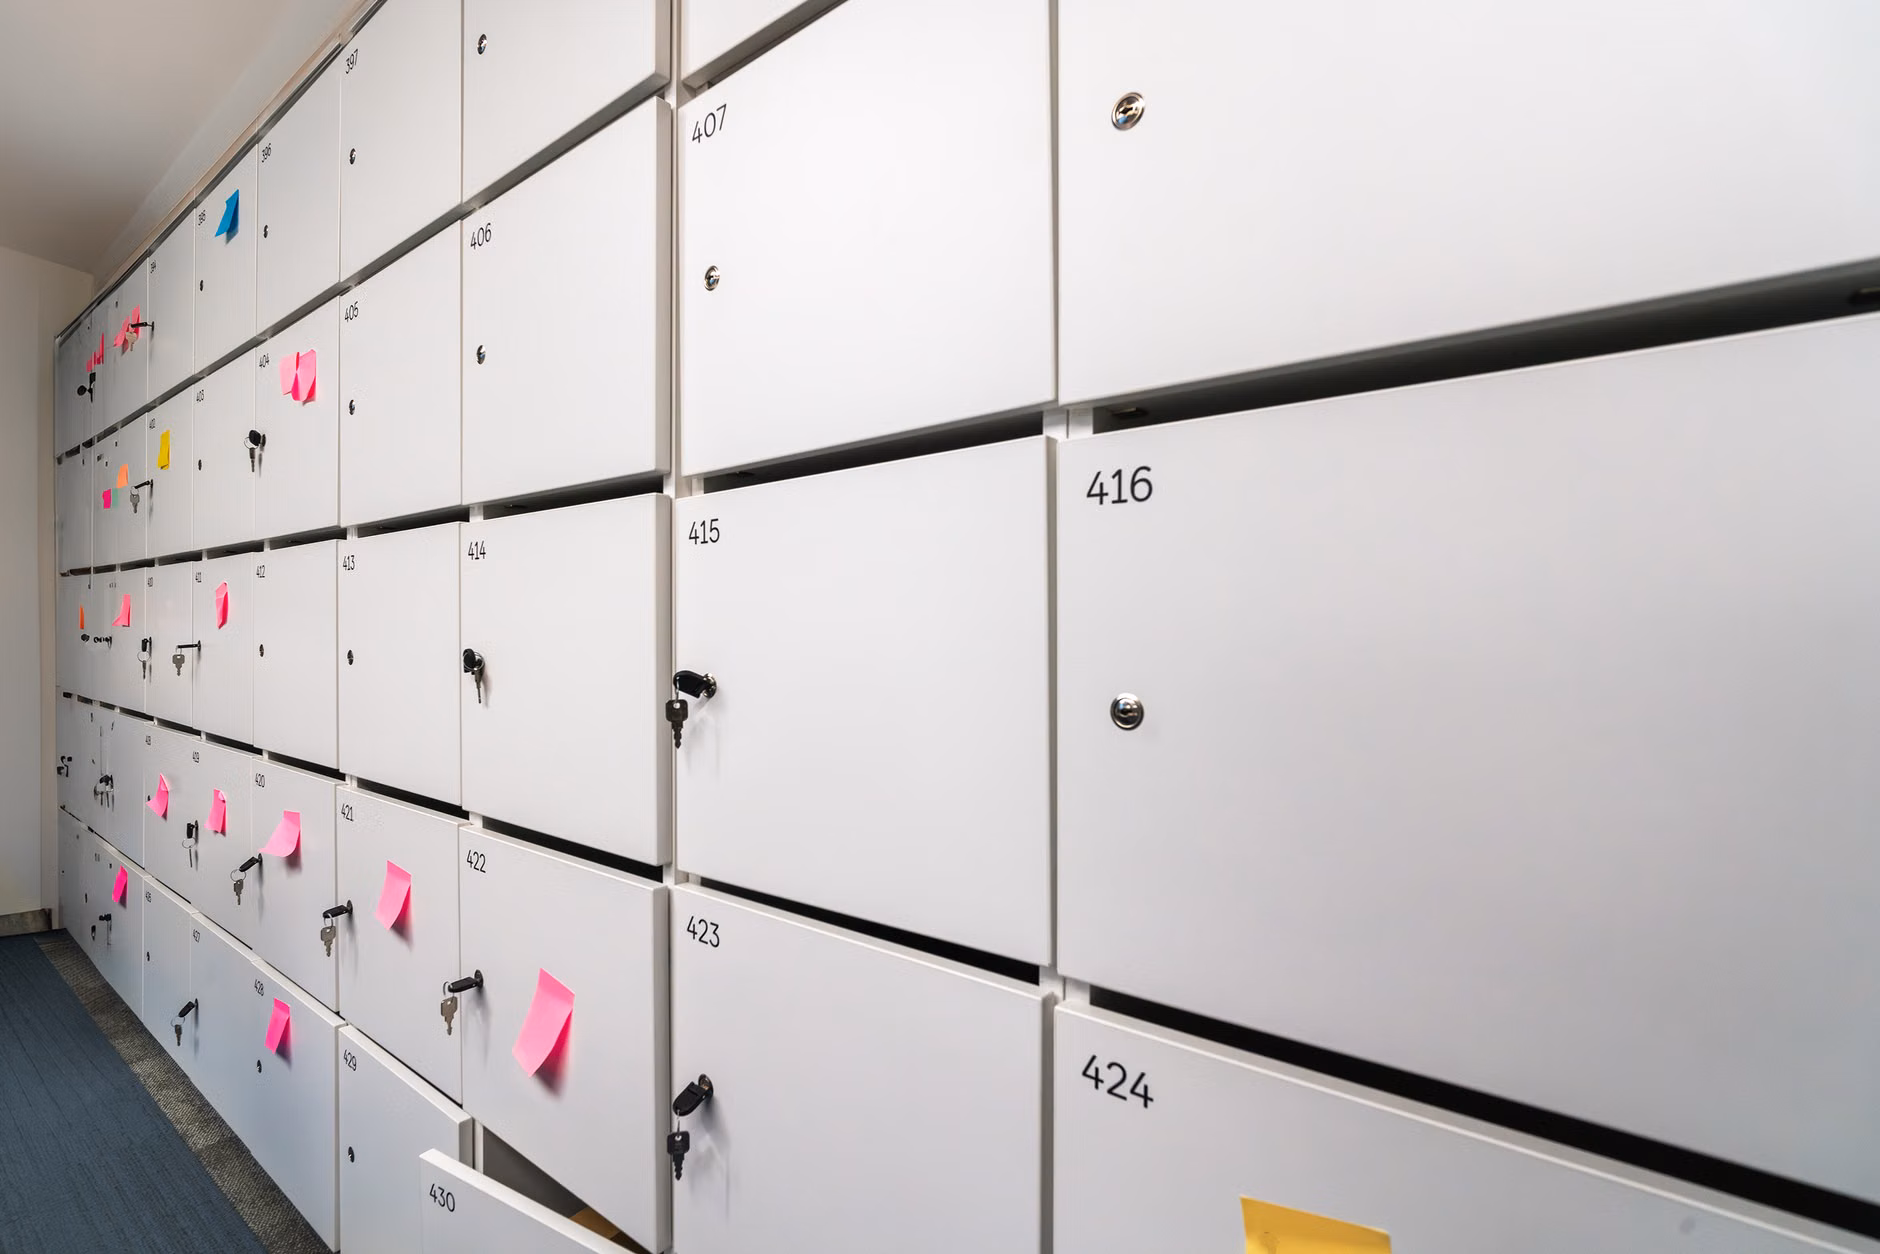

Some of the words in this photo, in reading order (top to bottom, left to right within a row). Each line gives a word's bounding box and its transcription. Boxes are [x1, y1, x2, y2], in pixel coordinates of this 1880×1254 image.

[346, 48, 358, 74] 397
[692, 103, 726, 144] 407
[261, 142, 271, 163] 396
[471, 223, 491, 249] 406
[345, 300, 358, 322] 405
[259, 352, 269, 369] 404
[1087, 466, 1152, 505] 416
[689, 518, 719, 544] 415
[468, 541, 486, 560] 414
[256, 565, 265, 578] 412
[343, 555, 355, 570] 413
[255, 773, 265, 788] 420
[342, 804, 354, 822] 421
[467, 850, 486, 873] 422
[687, 916, 719, 948] 423
[344, 1050, 356, 1071] 429
[1082, 1055, 1154, 1108] 424
[430, 1184, 455, 1212] 430
